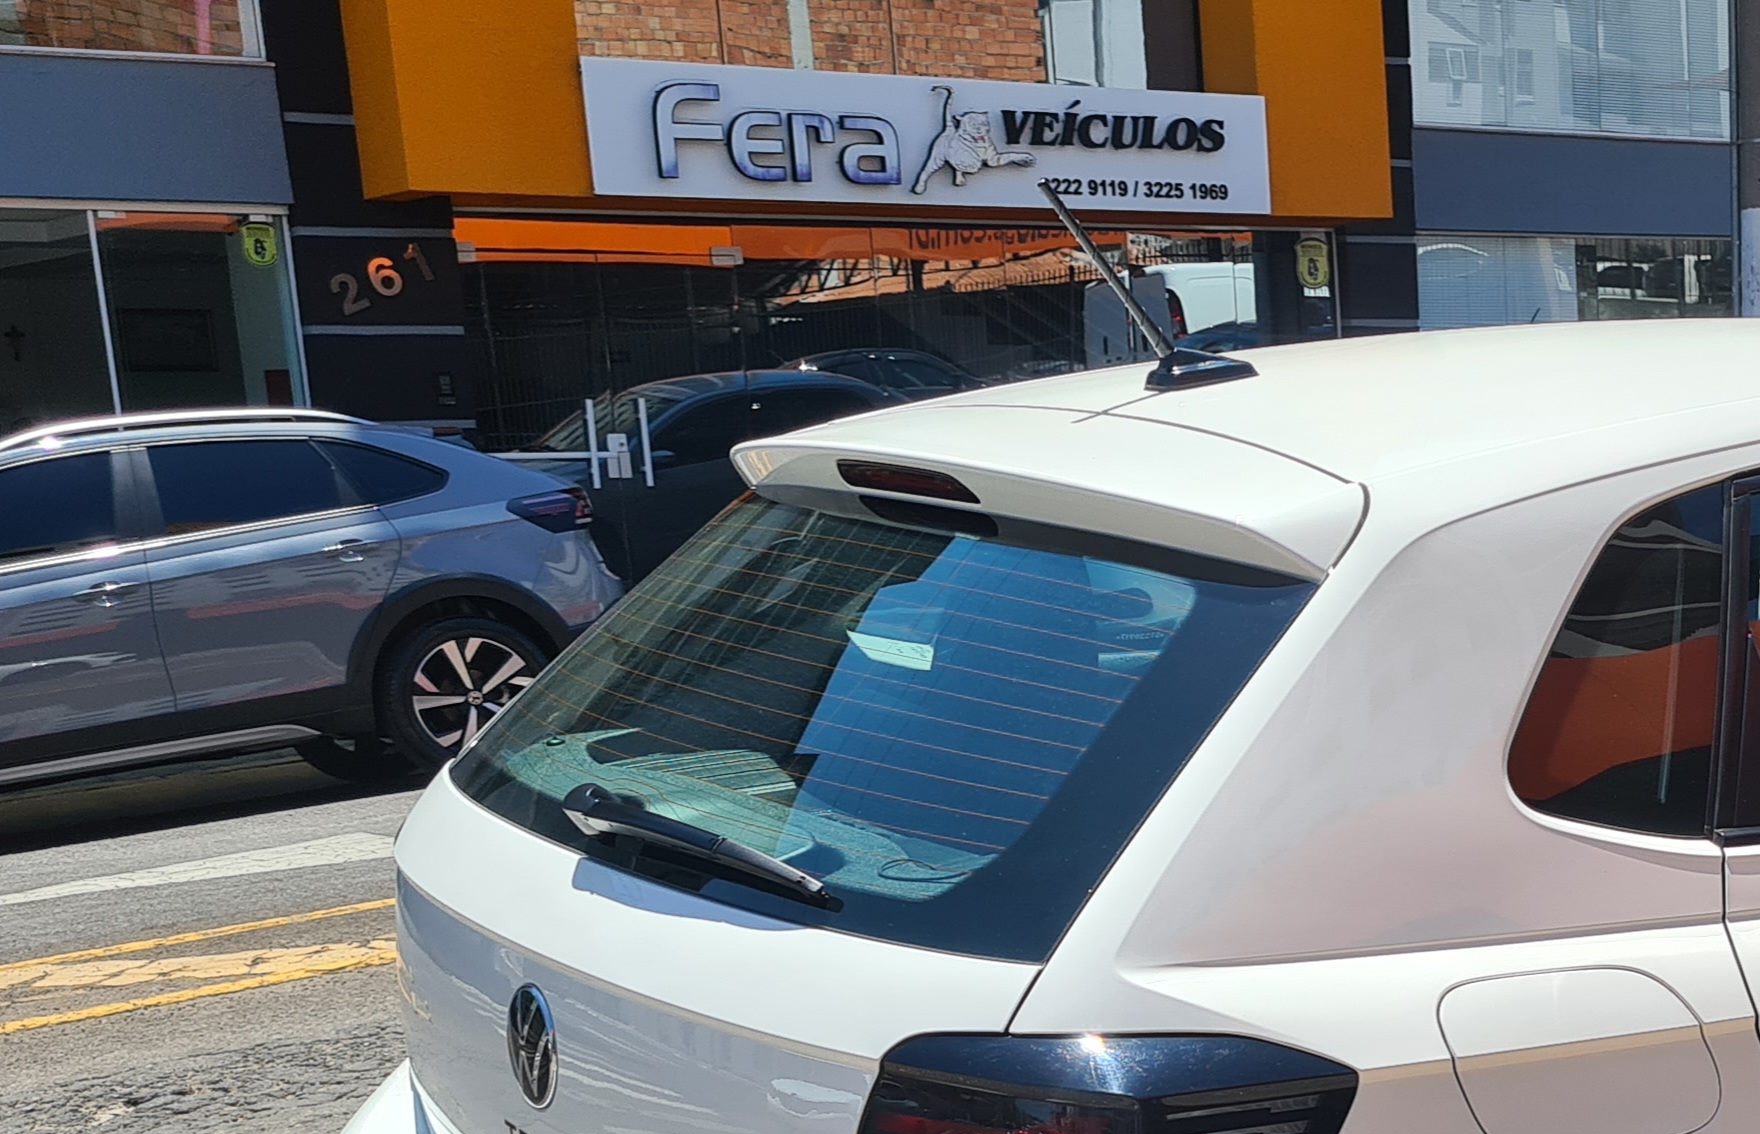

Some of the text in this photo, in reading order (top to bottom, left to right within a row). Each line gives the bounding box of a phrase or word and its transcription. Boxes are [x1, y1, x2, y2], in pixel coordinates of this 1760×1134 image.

[652, 80, 902, 185] Fera
[1000, 99, 1226, 153] VEÍCULOS
[1087, 180, 1129, 197] 9119
[1143, 181, 1185, 200] 3225
[1188, 183, 1229, 200] 1969
[330, 242, 435, 316] 261
